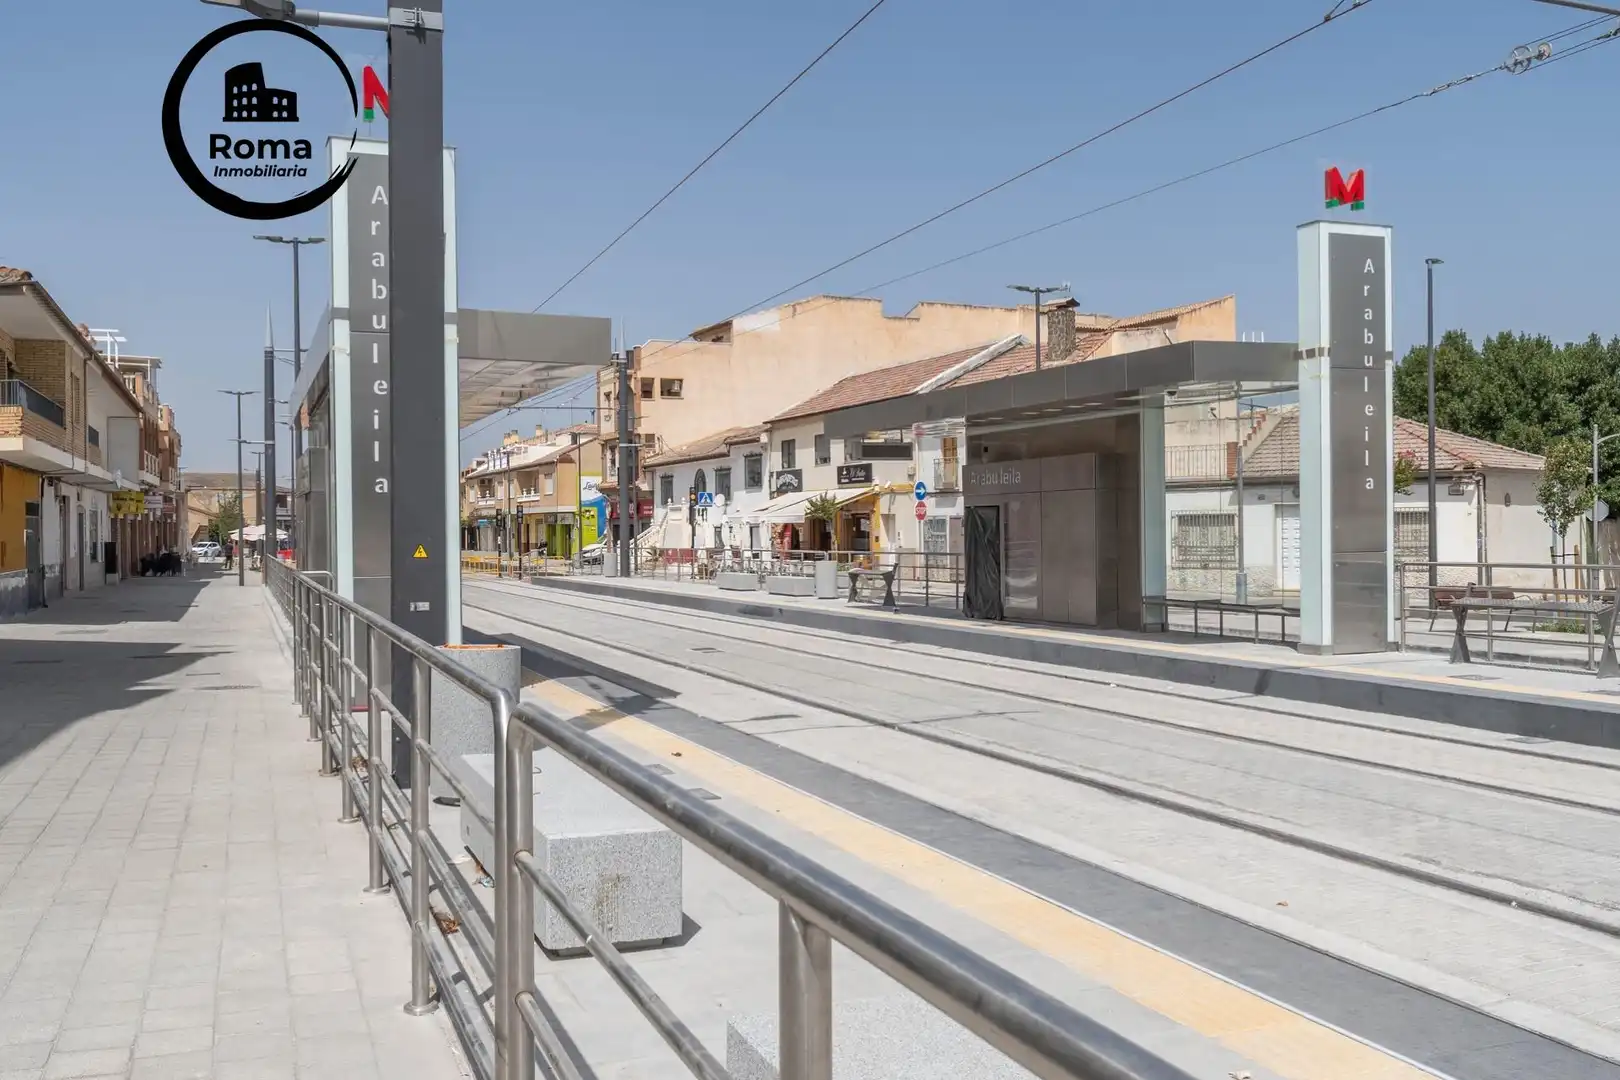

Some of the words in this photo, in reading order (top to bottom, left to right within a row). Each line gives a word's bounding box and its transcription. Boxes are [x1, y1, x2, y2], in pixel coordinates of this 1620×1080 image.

[370, 184, 389, 494] Arabuleila
[1362, 257, 1375, 490] Arabuleila
[969, 466, 1022, 486] Arabuleila
